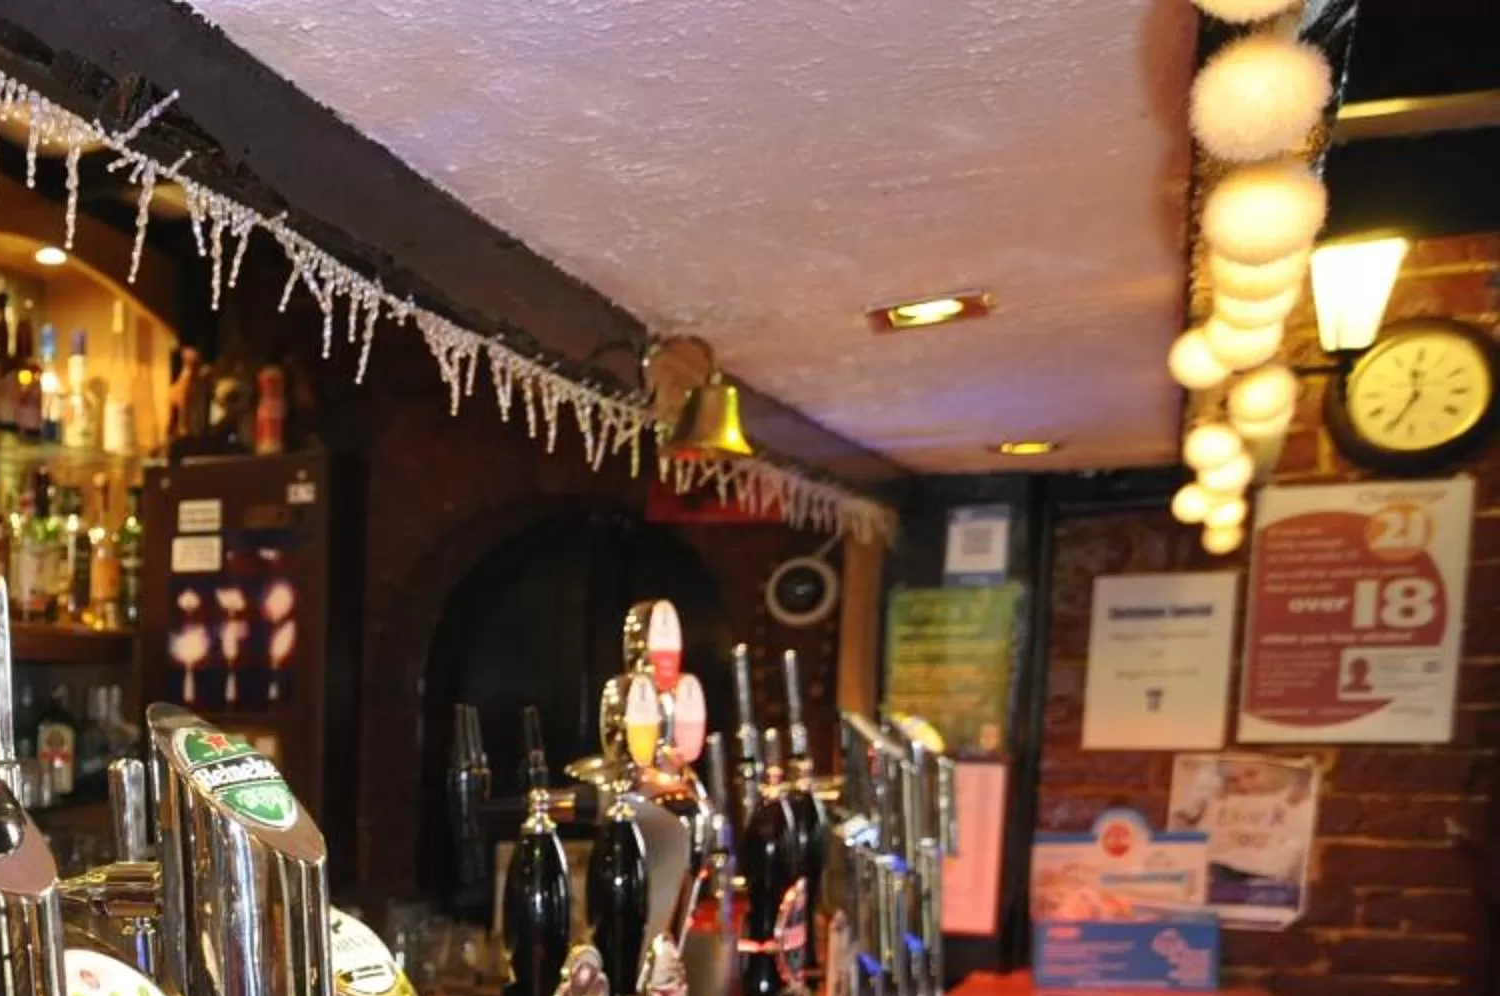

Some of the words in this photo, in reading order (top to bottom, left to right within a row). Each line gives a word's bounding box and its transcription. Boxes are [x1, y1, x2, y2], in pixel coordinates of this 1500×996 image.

[1369, 512, 1426, 550] 21
[1287, 596, 1350, 614] over
[1351, 576, 1437, 630] 18
